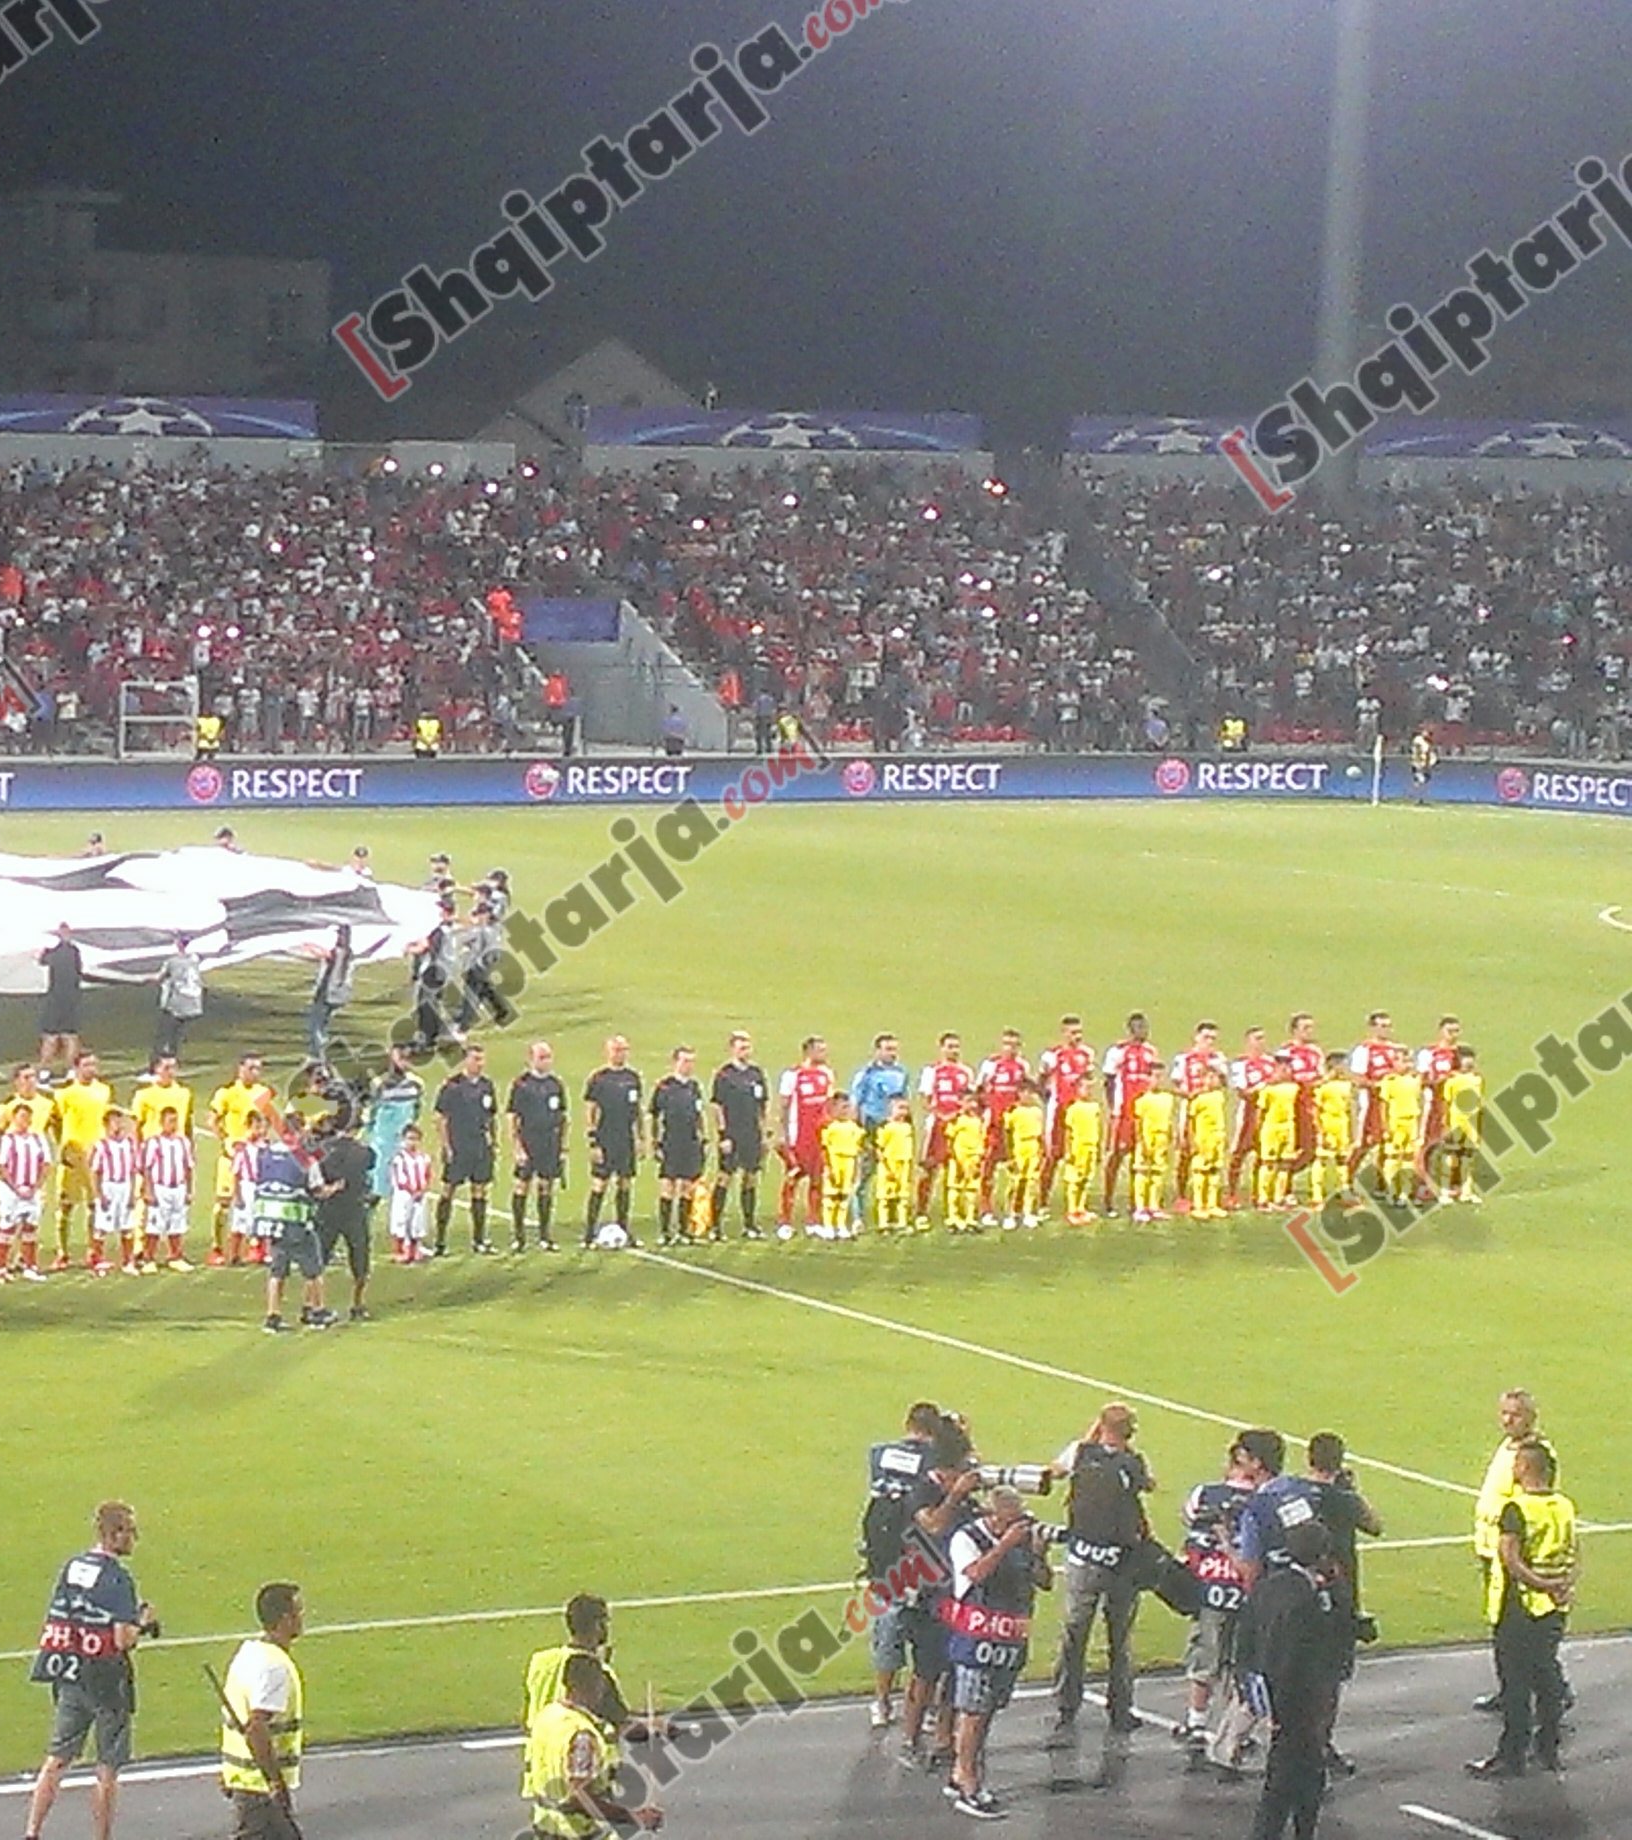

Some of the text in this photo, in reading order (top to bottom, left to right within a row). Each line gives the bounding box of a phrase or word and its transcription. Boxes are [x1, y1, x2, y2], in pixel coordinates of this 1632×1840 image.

[231, 769, 364, 799] RESPECT
[568, 765, 694, 795] RESPECT
[883, 763, 1001, 791] RESPECT
[1197, 763, 1328, 790] RESPECT
